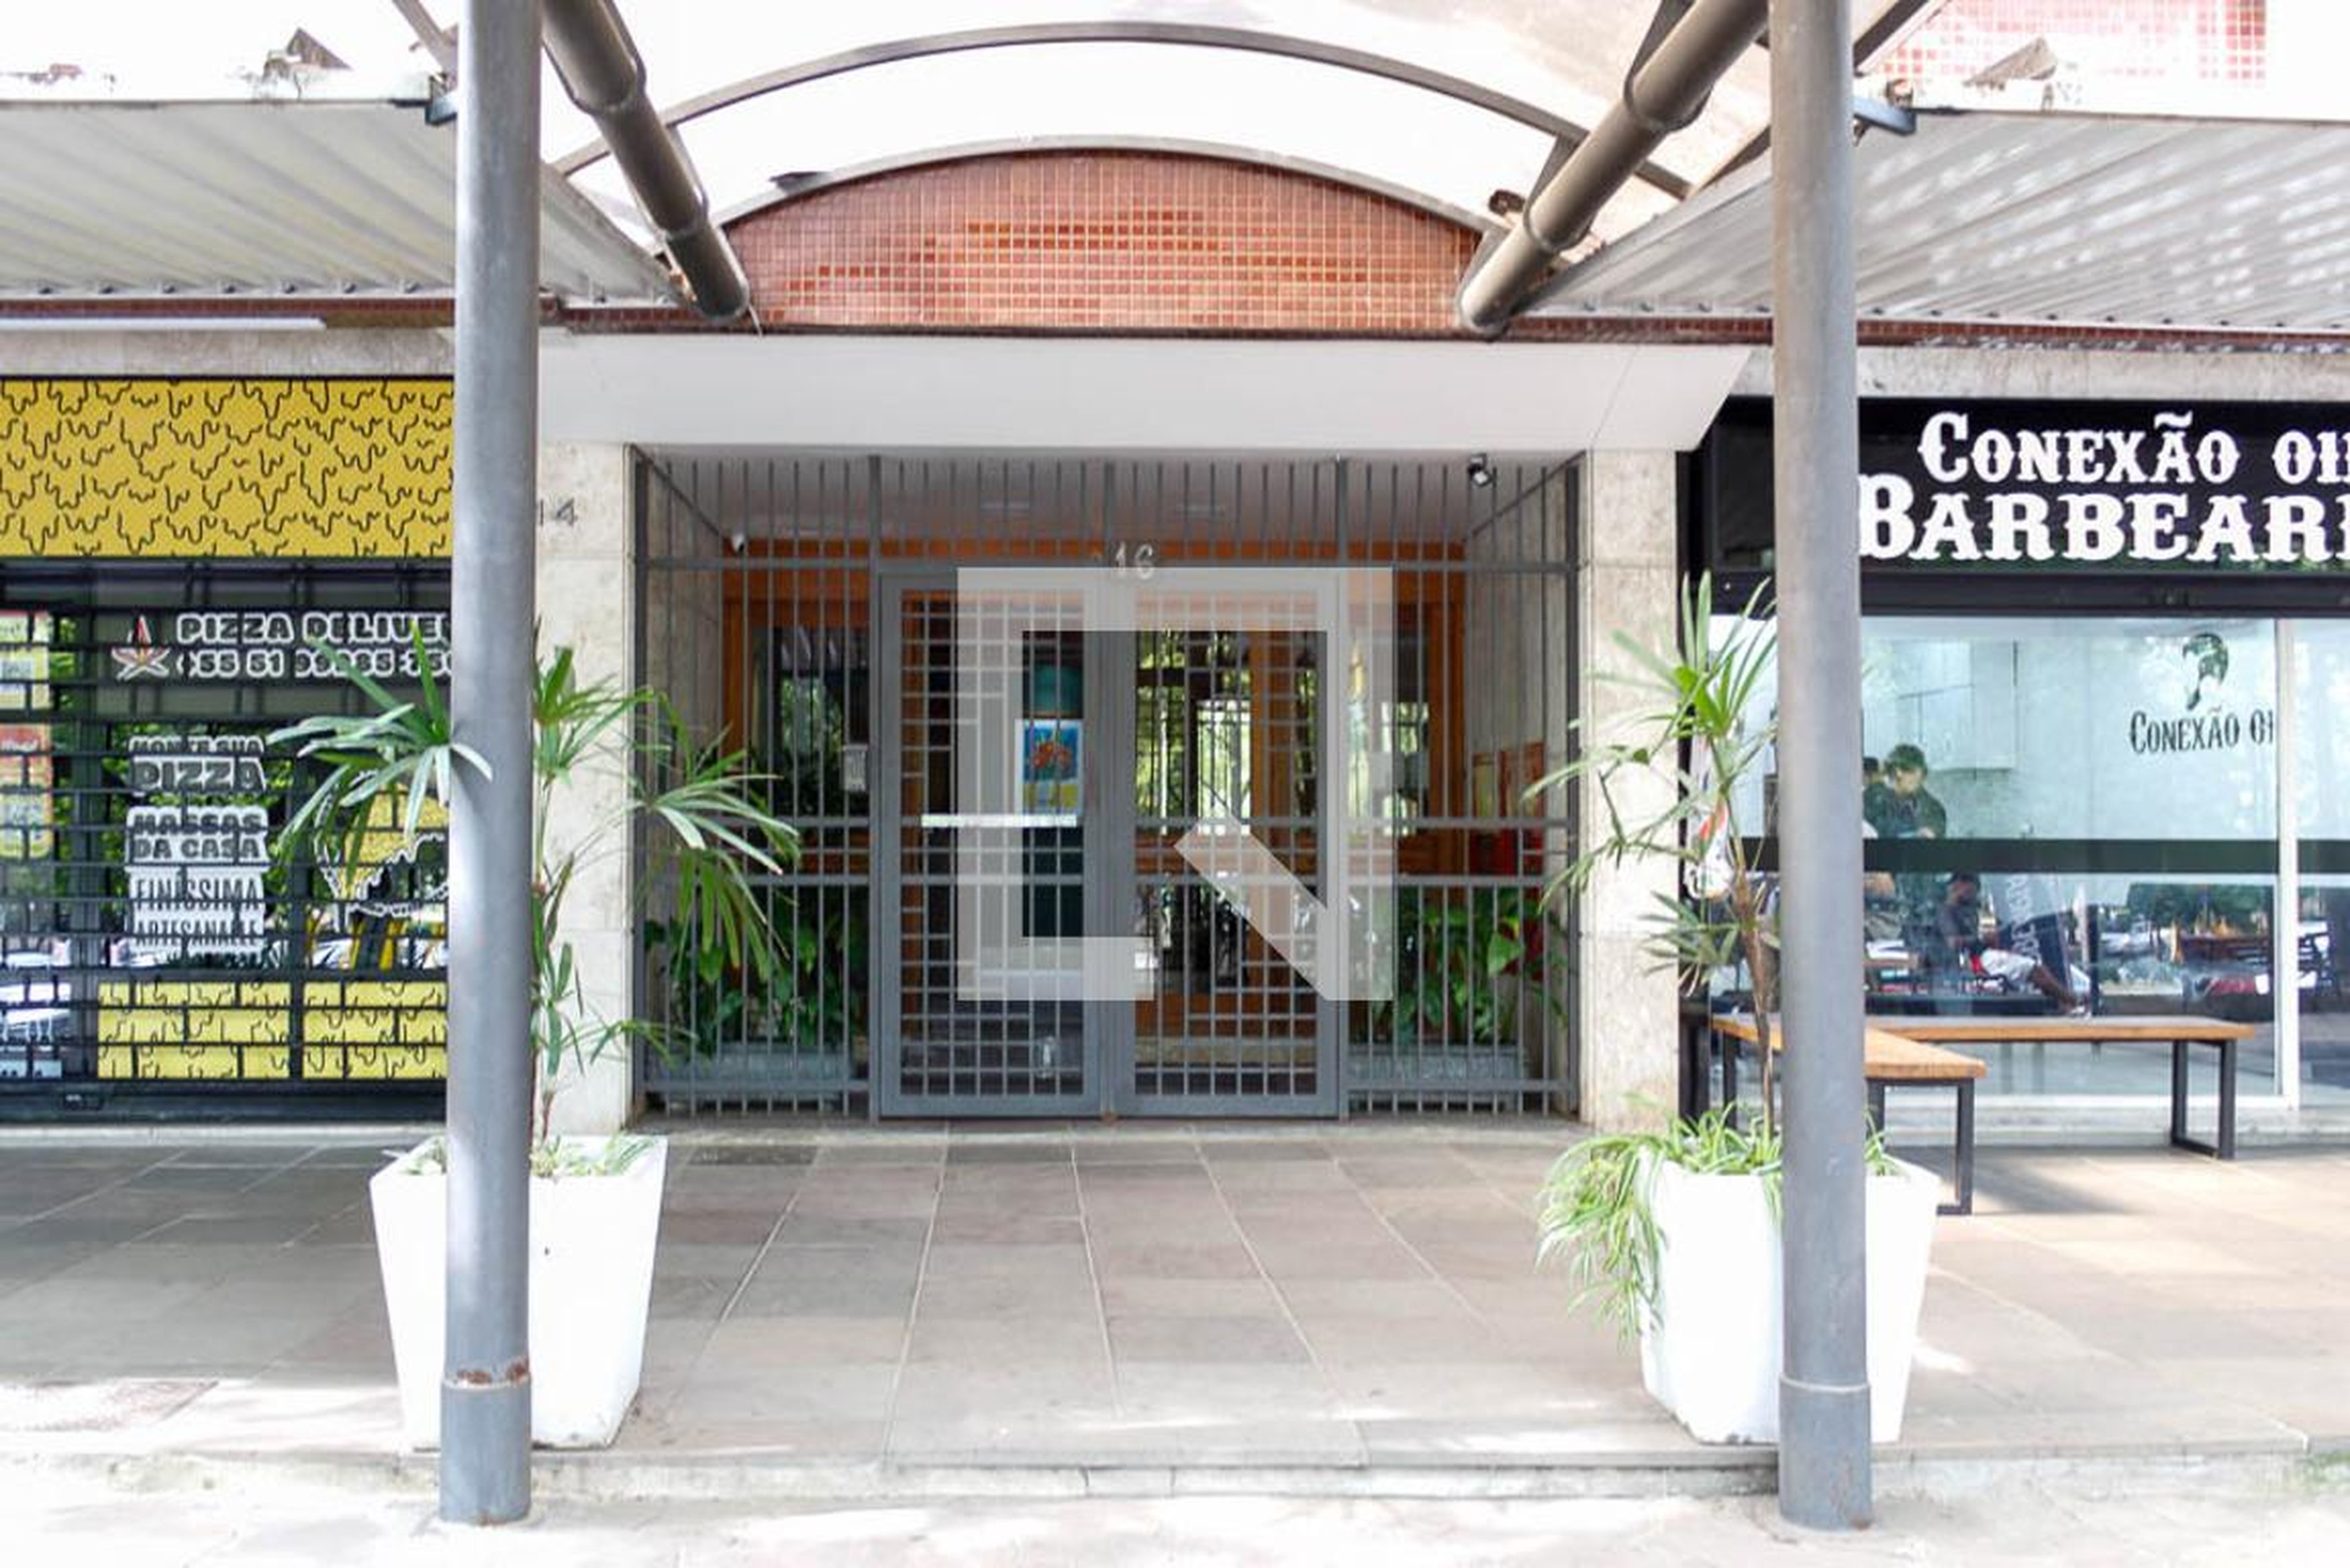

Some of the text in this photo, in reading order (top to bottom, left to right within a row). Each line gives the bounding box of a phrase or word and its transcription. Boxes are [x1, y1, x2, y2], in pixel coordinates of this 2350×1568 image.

[1115, 540, 1155, 580] 16
[177, 614, 295, 643] PIZZA
[247, 650, 285, 677] 51
[131, 759, 263, 793] PIZZA
[132, 838, 260, 858] DA CASA
